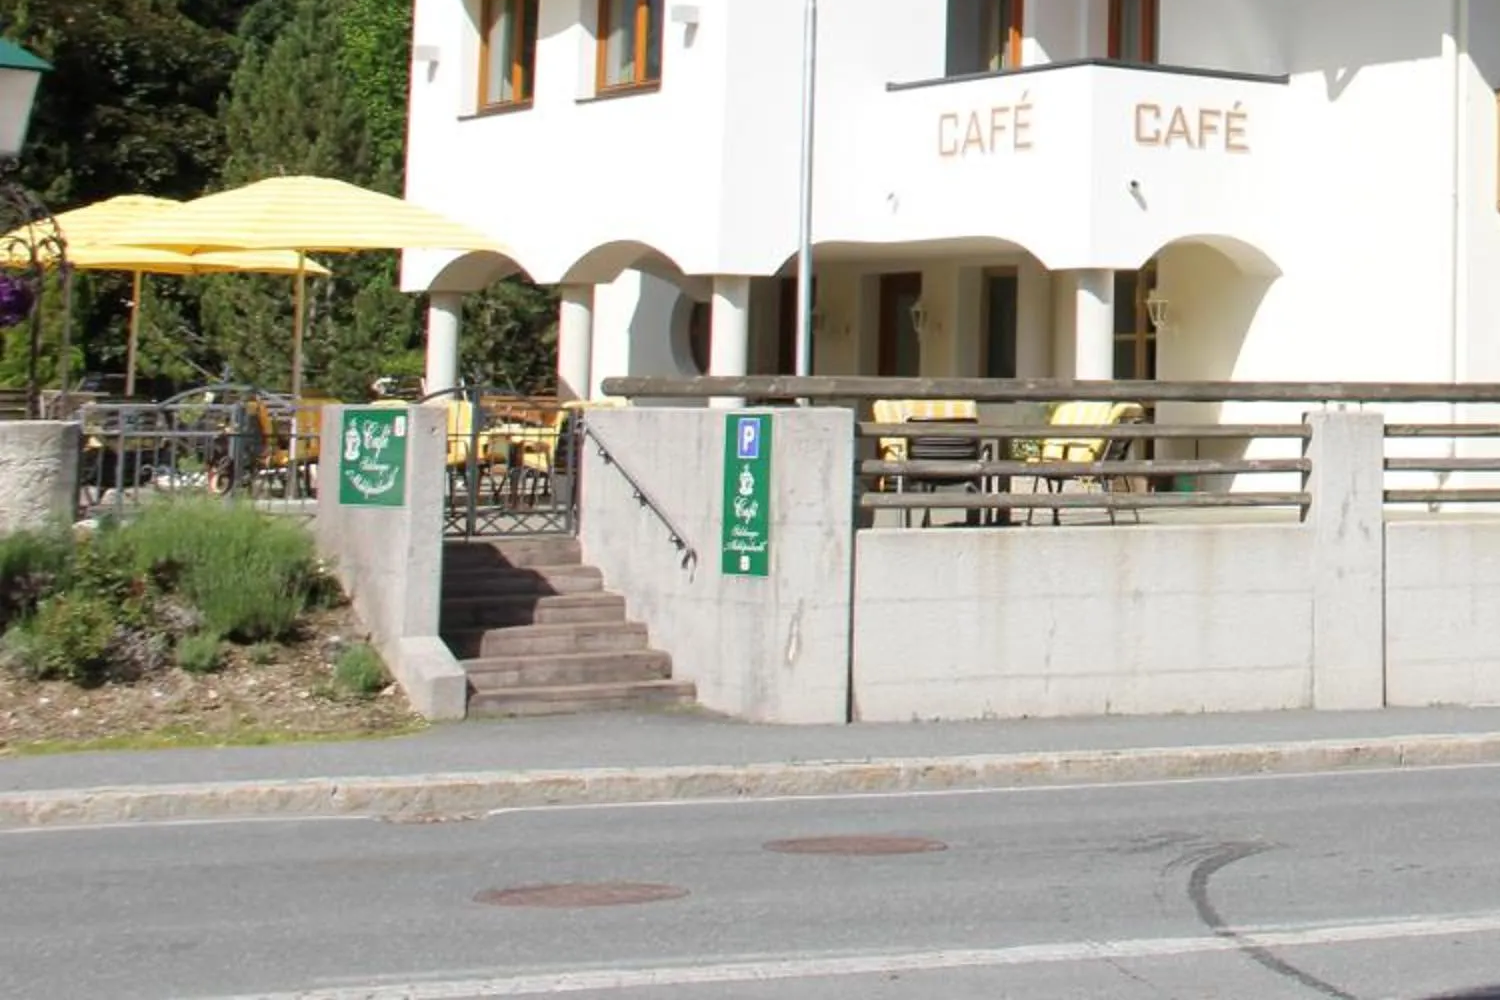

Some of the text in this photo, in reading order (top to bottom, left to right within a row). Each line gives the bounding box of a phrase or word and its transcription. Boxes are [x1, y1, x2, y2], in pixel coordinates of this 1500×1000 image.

[938, 89, 1033, 157] CAFÉ
[1135, 100, 1249, 153] CAFÉ
[743, 425, 755, 452] P
